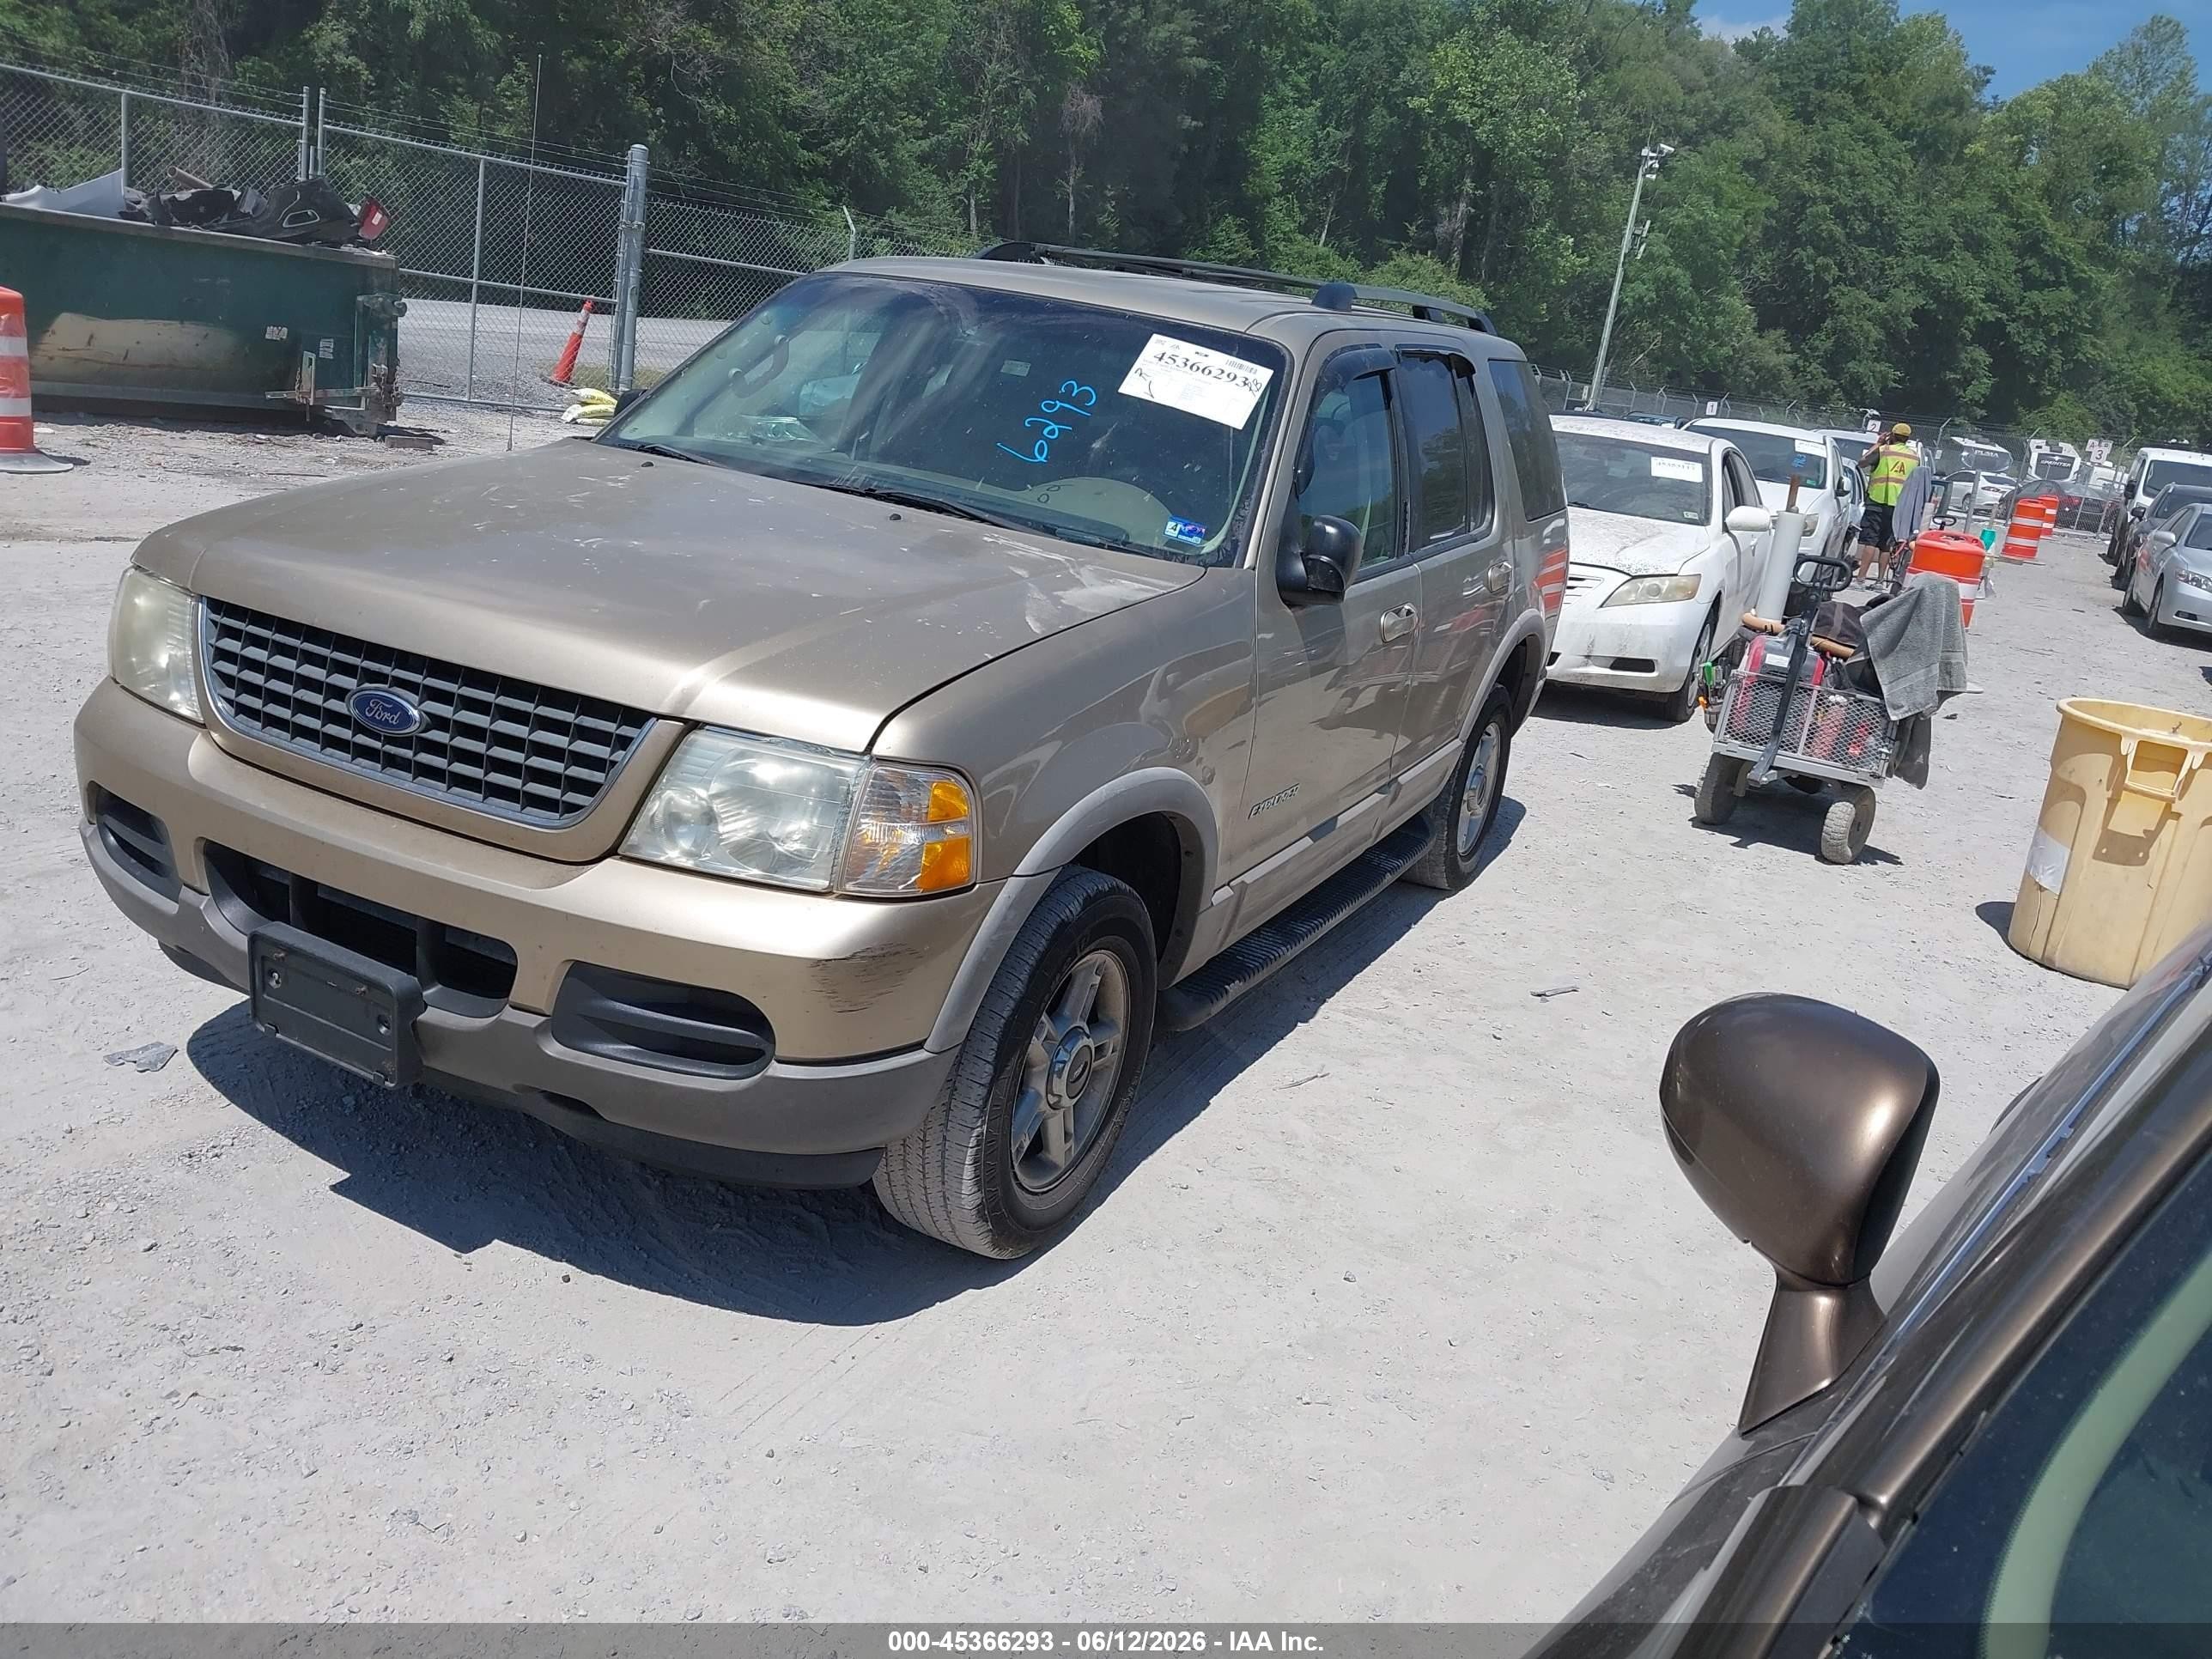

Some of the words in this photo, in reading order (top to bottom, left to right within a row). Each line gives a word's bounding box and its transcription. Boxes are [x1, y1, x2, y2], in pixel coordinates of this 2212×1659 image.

[1154, 352, 1249, 388] 45366293
[995, 380, 1097, 463] 6293
[1974, 449, 2000, 459] PUMA
[2095, 450, 2104, 460] 3
[2040, 459, 2072, 468] SPRINTER
[365, 698, 401, 725] Ford
